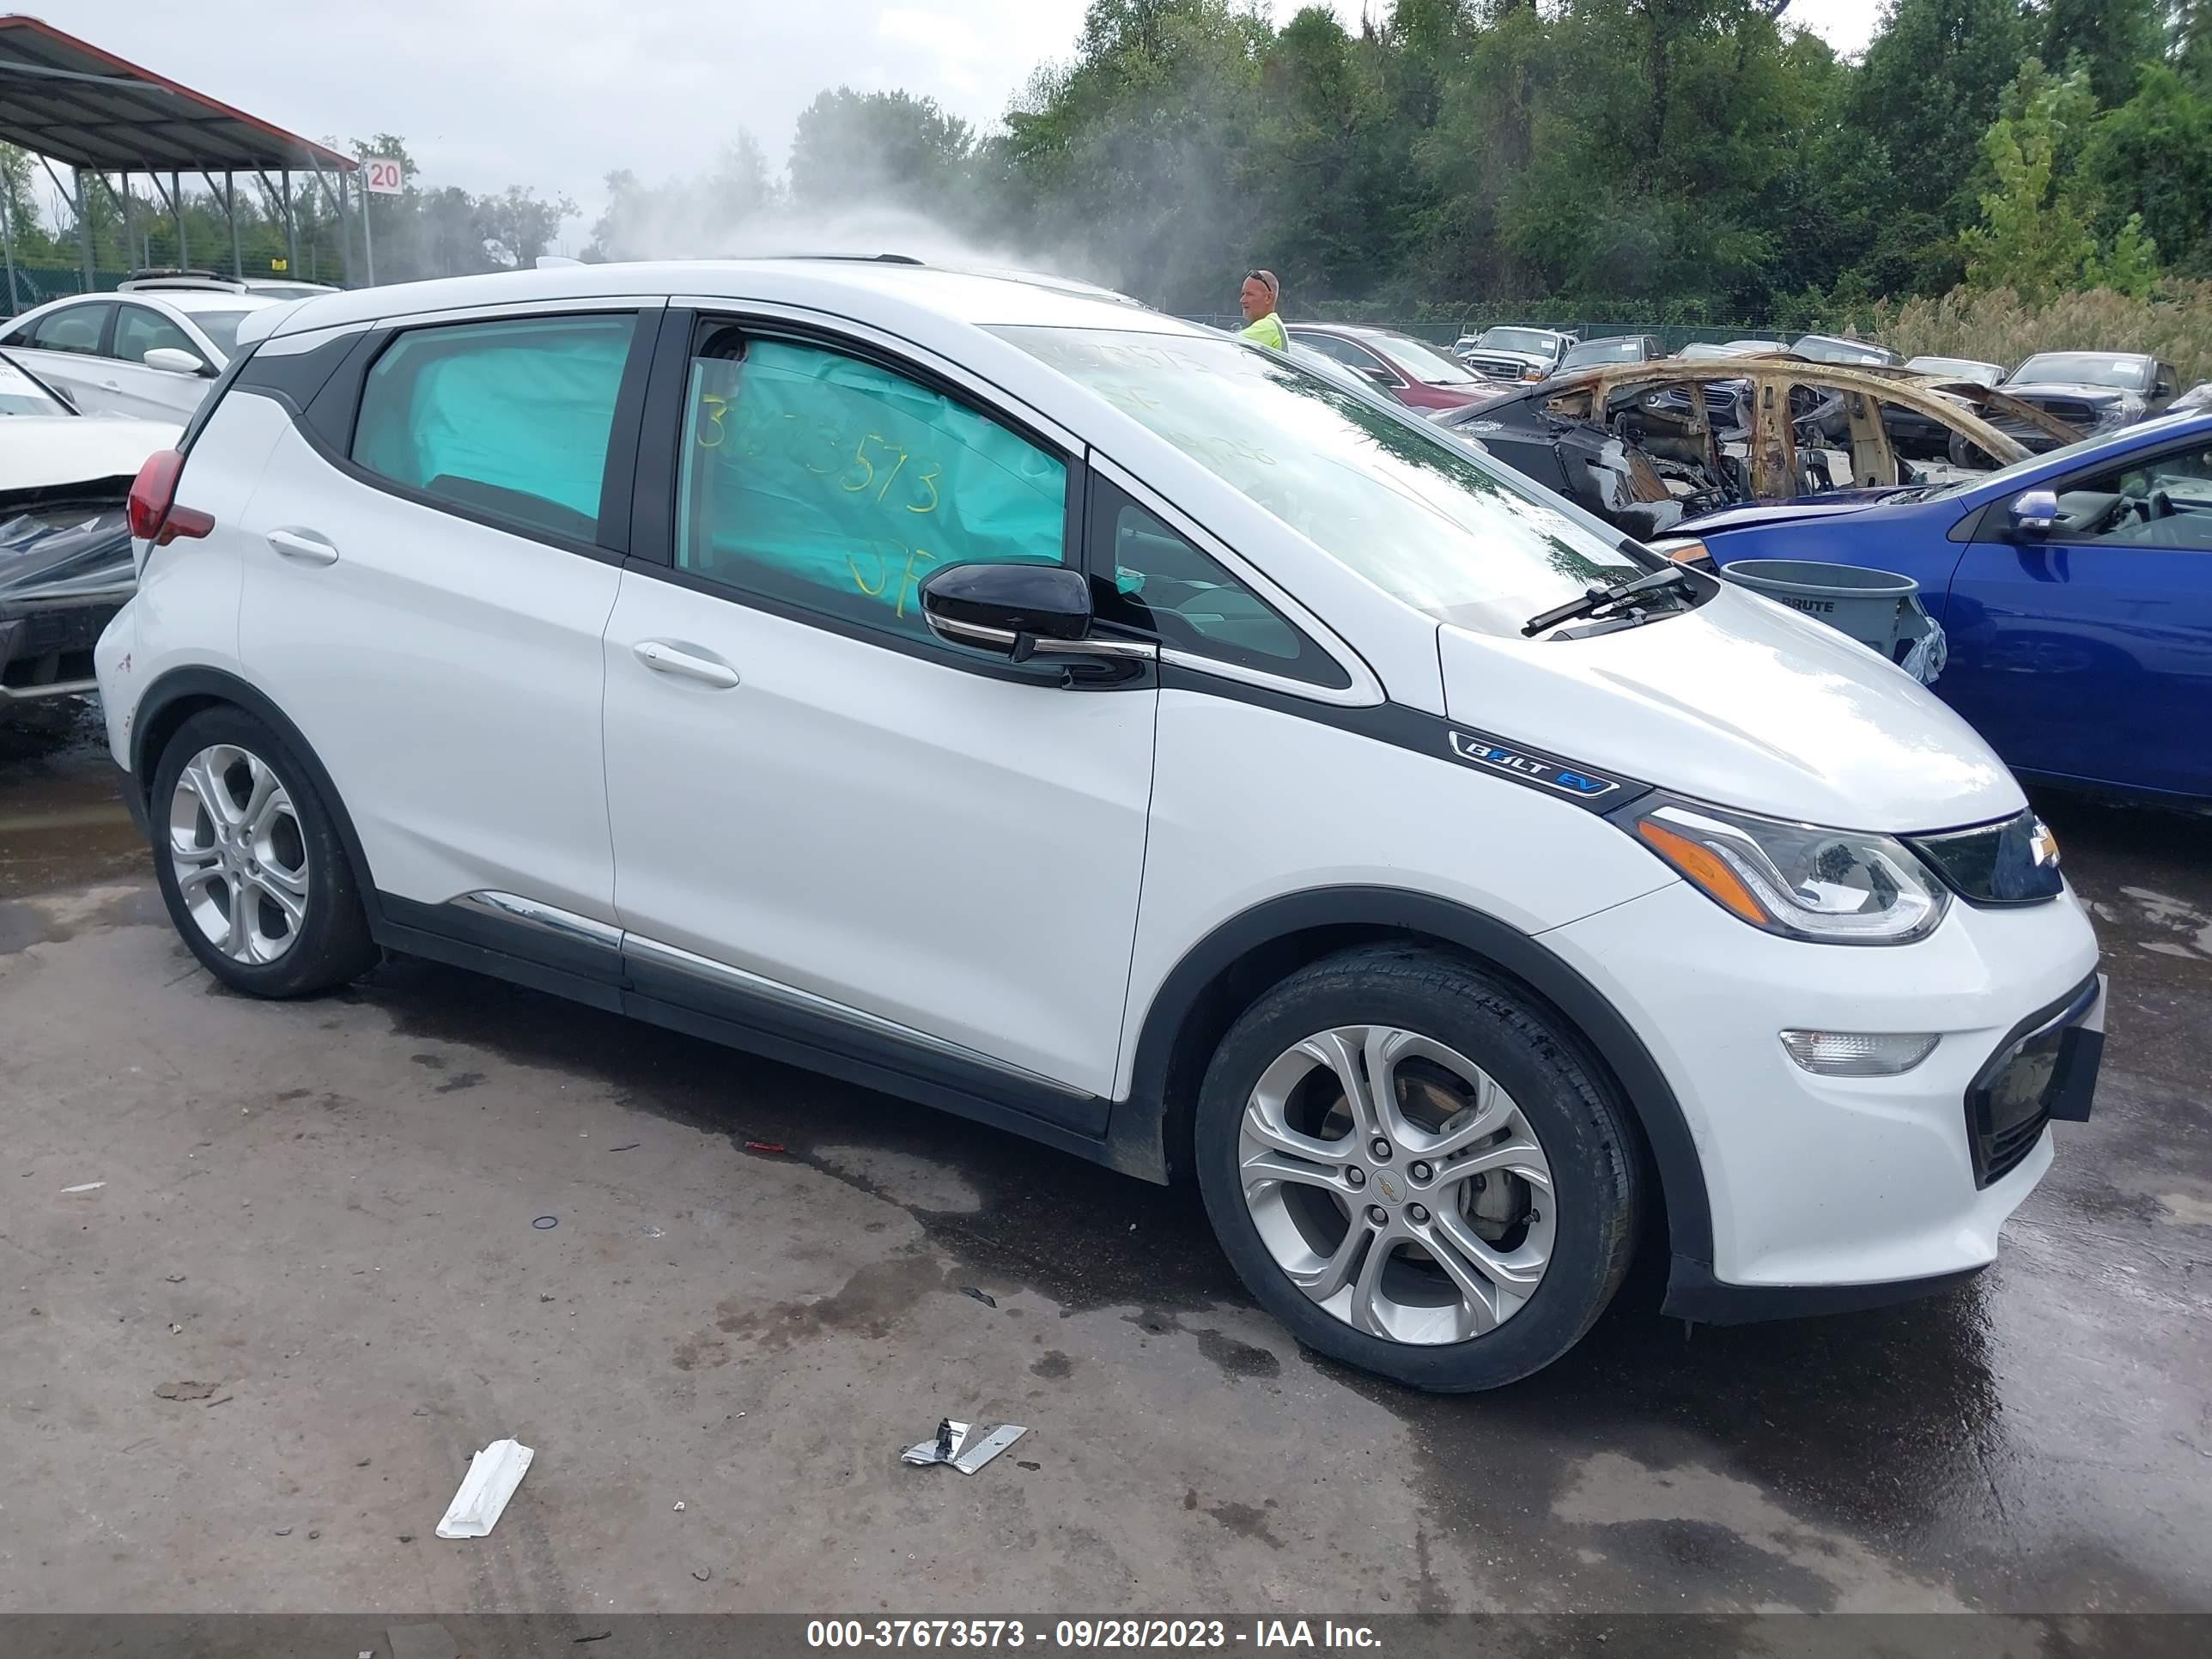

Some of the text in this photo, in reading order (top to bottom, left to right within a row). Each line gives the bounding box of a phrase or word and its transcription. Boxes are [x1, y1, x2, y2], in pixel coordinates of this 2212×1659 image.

[370, 163, 398, 187] 20
[1465, 742, 1602, 791] BOLT EV
